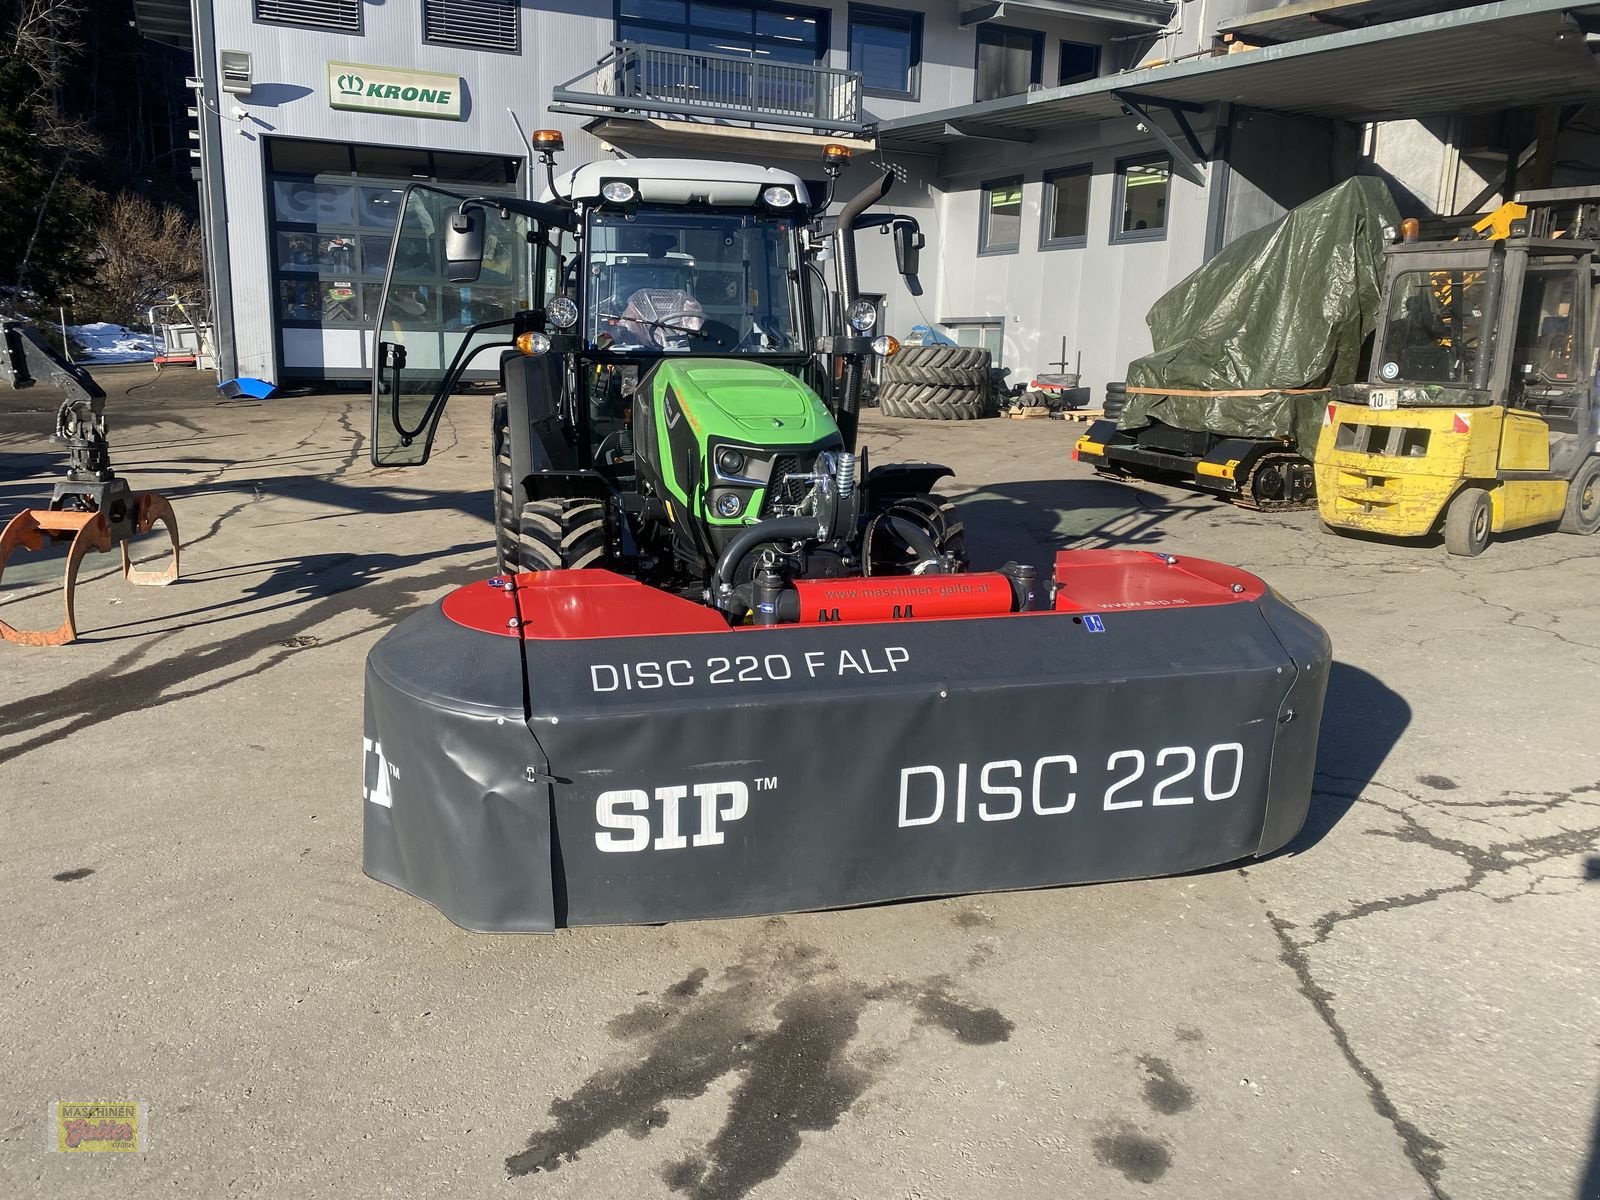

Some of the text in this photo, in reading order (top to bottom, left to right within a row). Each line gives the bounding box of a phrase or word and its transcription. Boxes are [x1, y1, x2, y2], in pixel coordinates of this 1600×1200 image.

[366, 83, 452, 104] KRONE
[1371, 392, 1384, 408] 10
[590, 646, 910, 692] DISC 220 F ALP
[898, 741, 1245, 828] DISC 220
[594, 780, 749, 853] SIP
